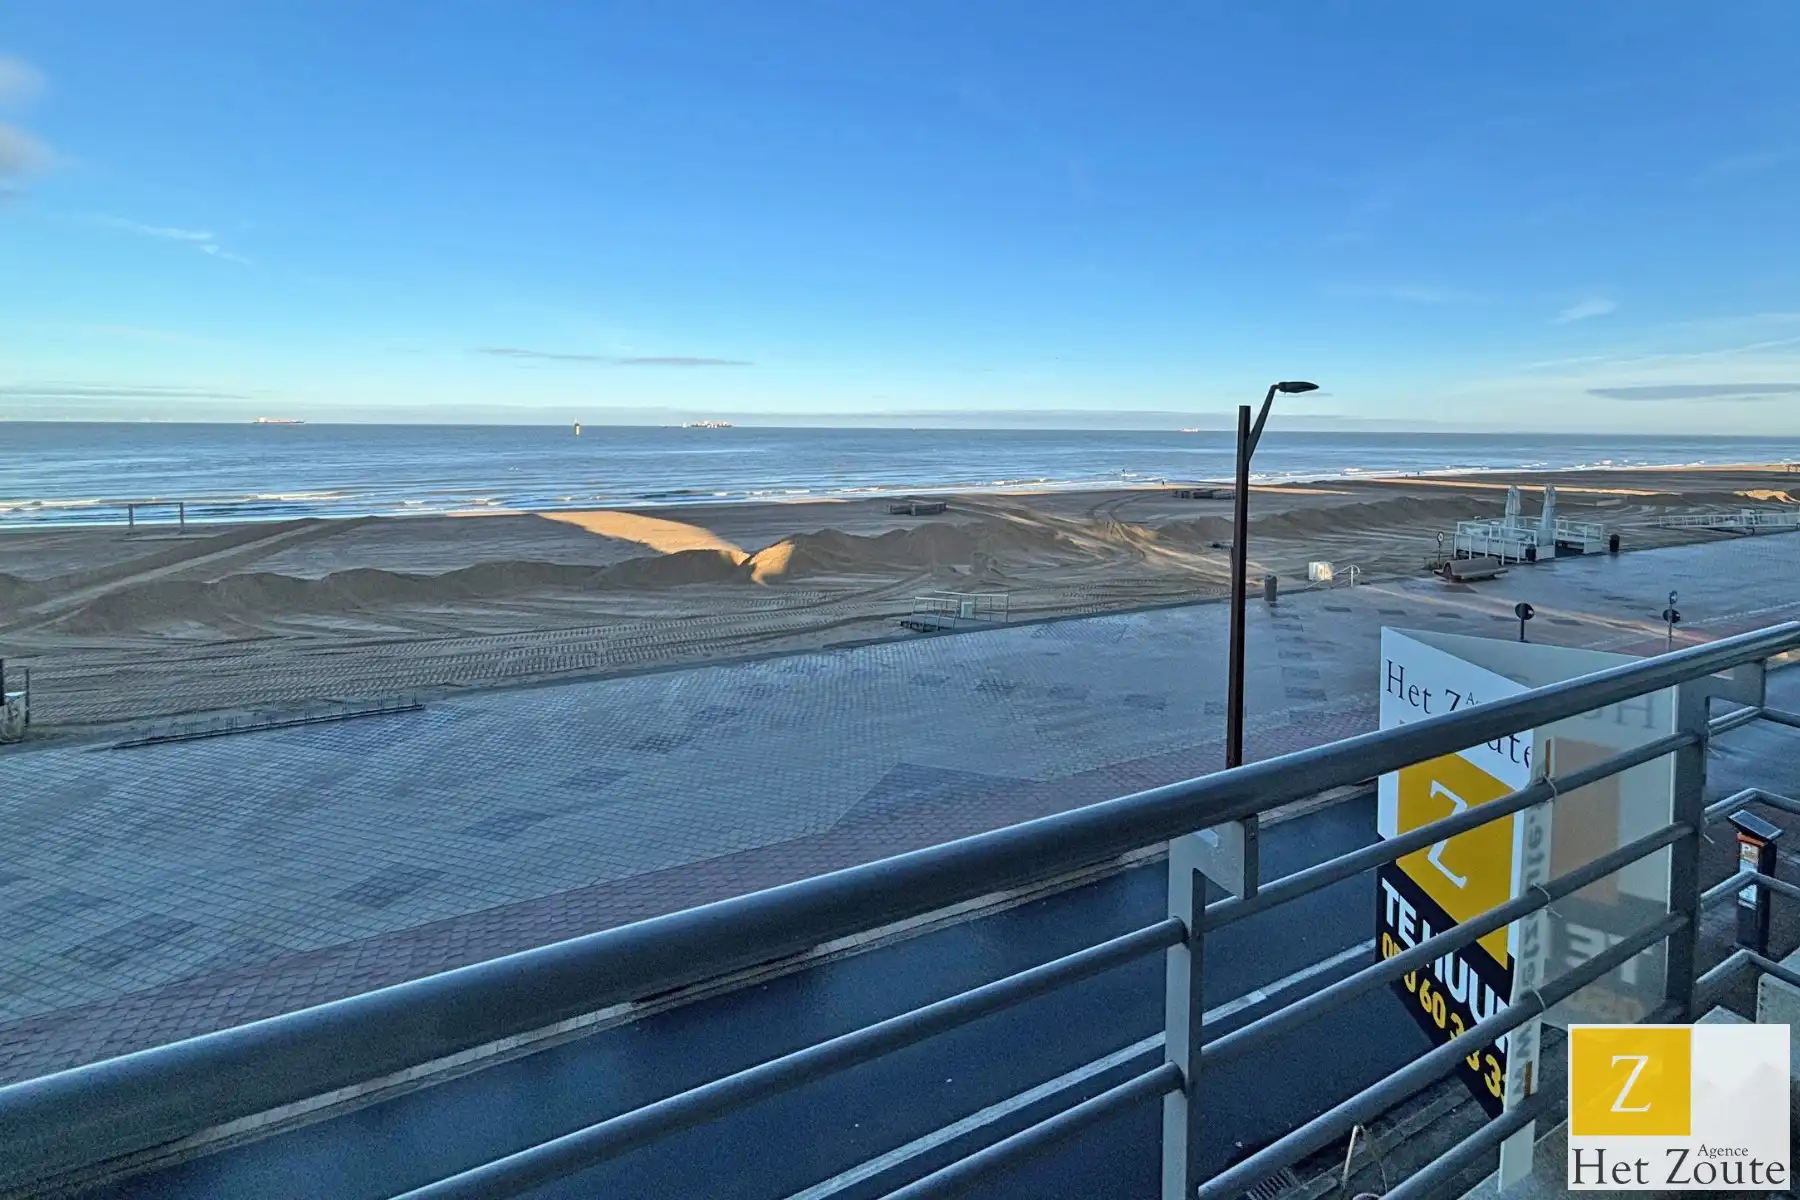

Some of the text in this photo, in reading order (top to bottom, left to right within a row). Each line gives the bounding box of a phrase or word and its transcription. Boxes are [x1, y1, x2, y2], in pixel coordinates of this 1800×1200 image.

[1387, 658, 1432, 715] Het
[1428, 779, 1468, 890] Z
[1382, 877, 1417, 949] TE
[1420, 977, 1446, 1029] 60
[1484, 1054, 1507, 1103] 3
